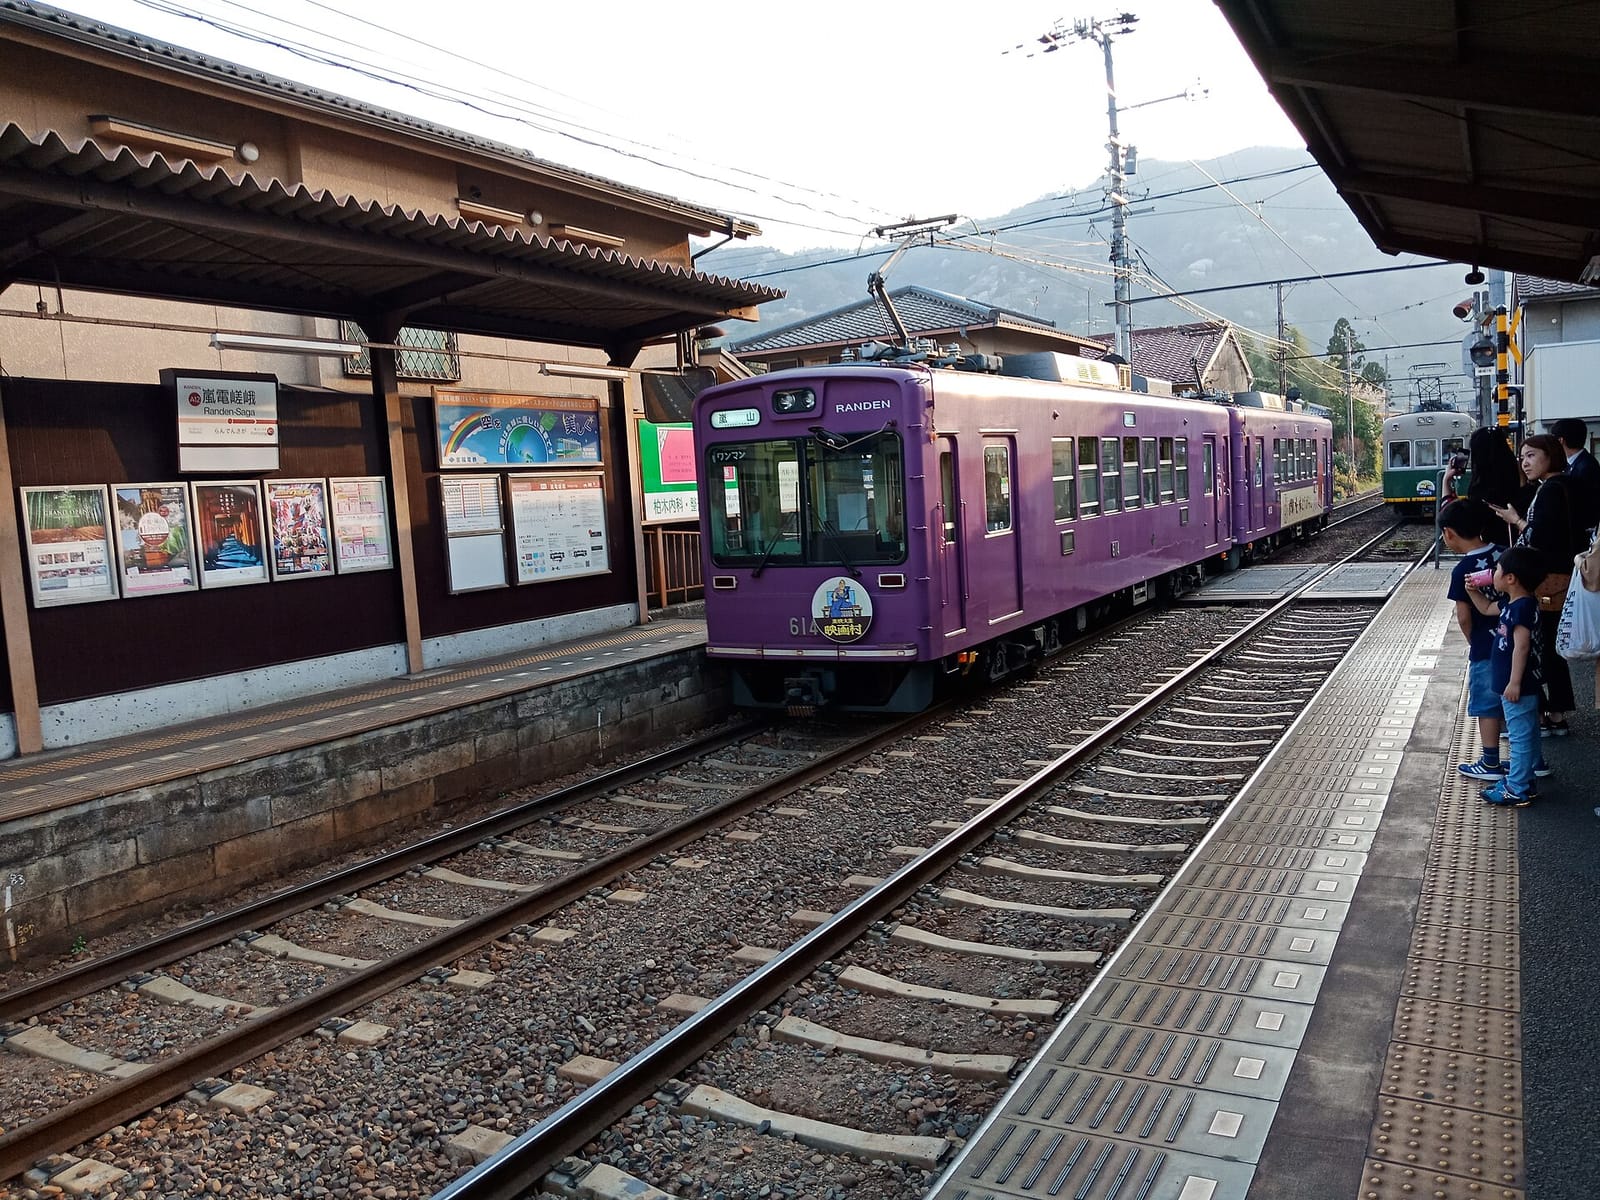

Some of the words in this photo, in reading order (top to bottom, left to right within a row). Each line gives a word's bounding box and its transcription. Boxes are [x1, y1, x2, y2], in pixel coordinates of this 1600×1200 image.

[202, 388, 257, 406] 嵐電嵯峨
[203, 406, 256, 417] Randen-Saga
[835, 399, 891, 413] RANDEN
[480, 414, 501, 430] 空を
[716, 450, 746, 462] ワンマン
[789, 617, 819, 636] 614
[823, 623, 862, 636] 映画村
